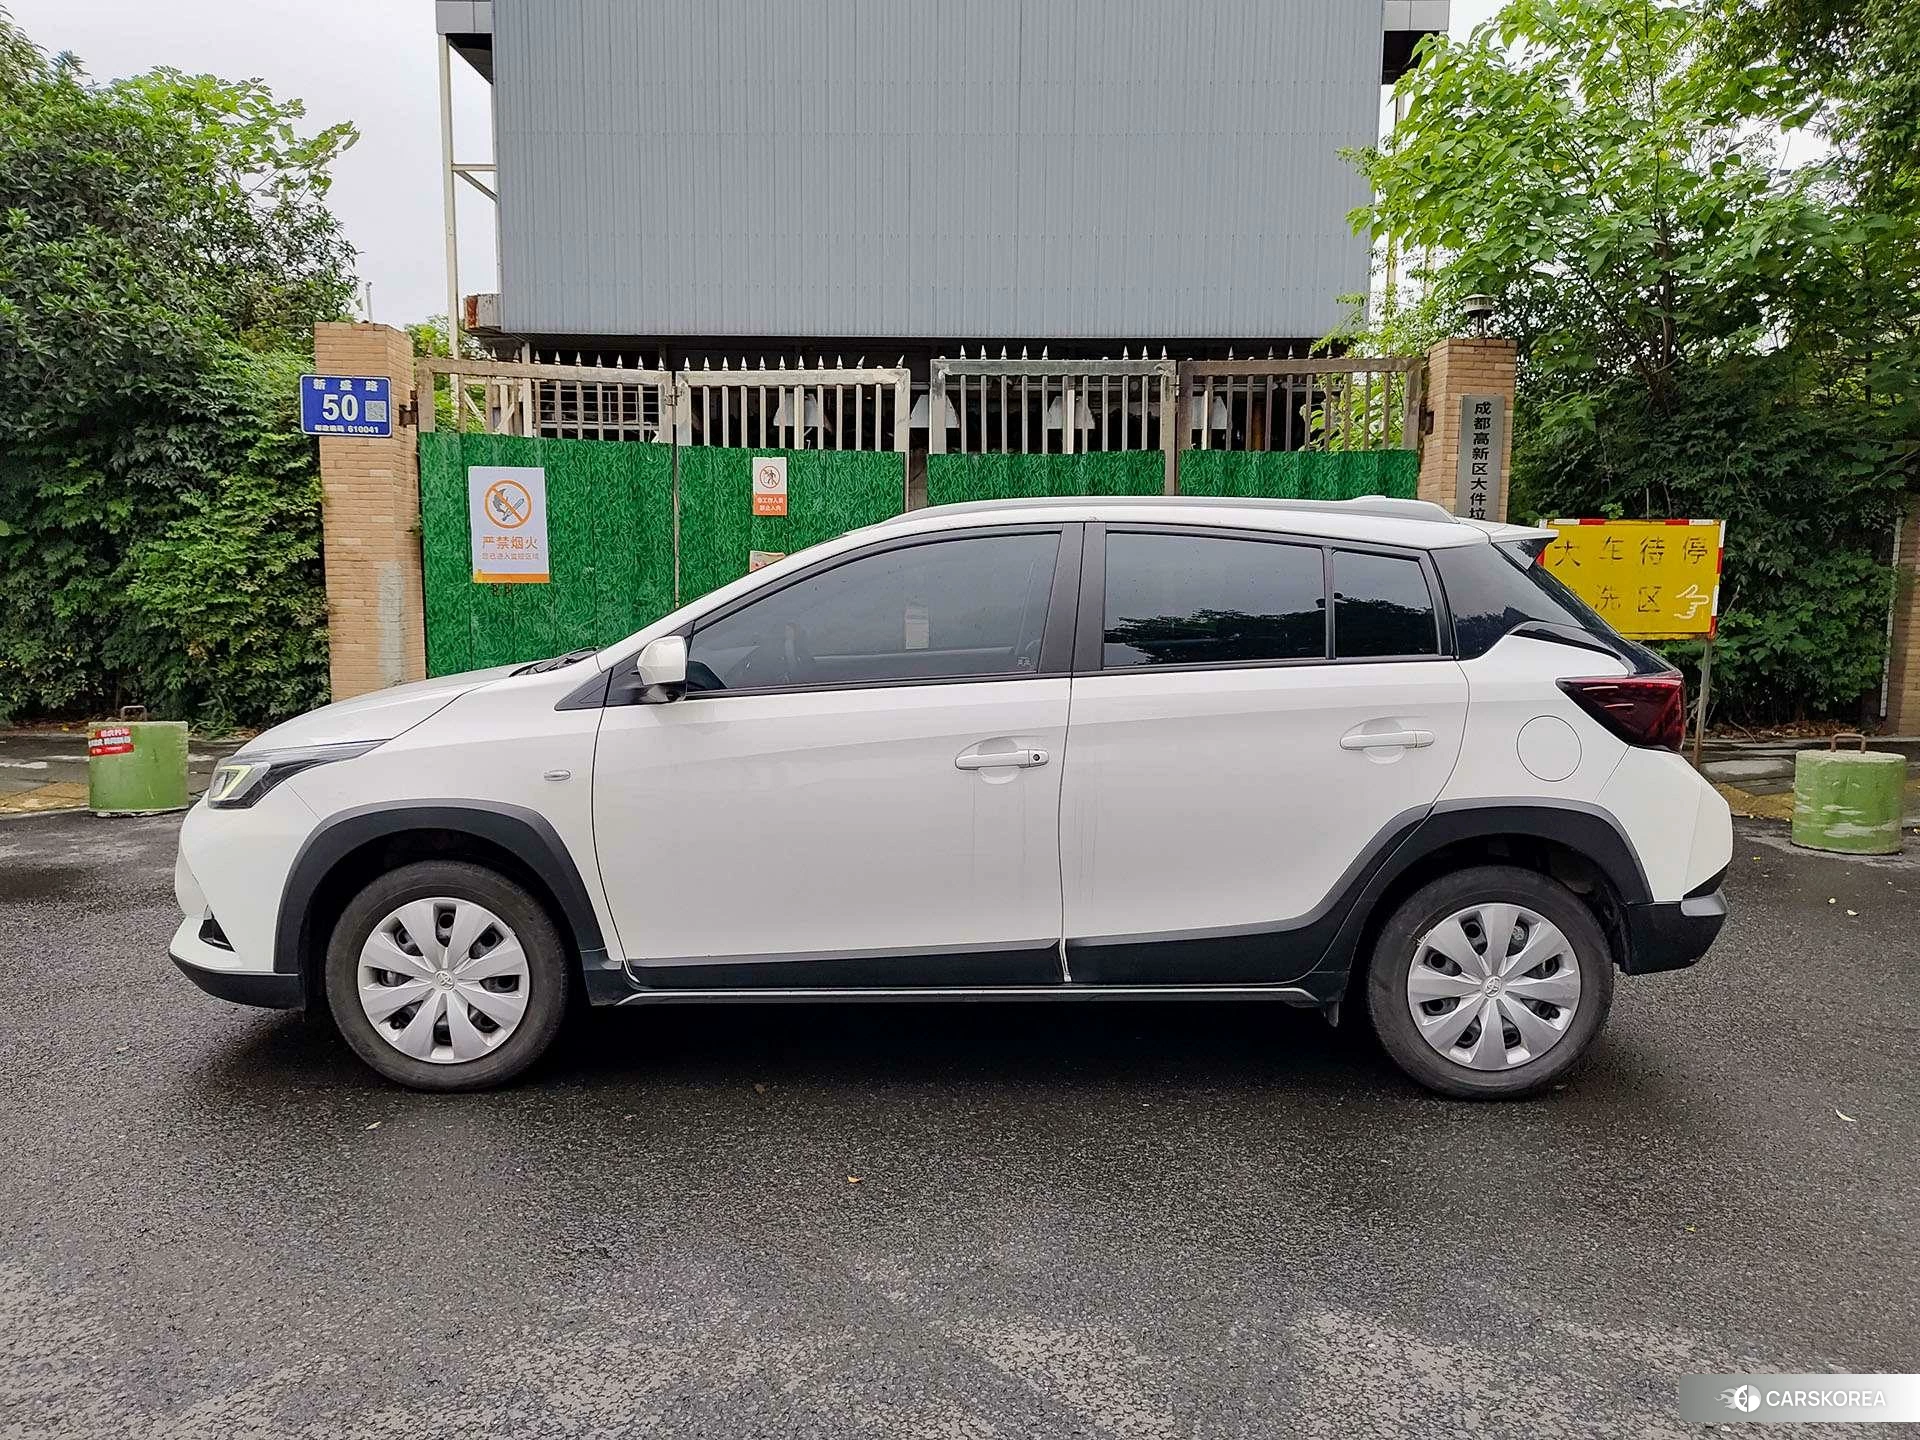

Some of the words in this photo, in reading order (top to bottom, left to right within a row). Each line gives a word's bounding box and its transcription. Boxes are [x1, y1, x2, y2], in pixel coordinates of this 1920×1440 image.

[322, 394, 359, 421] 50
[347, 425, 379, 434] 610041
[1469, 401, 1492, 520] 成都高新区大件垃
[481, 535, 538, 549] 严禁烟火
[1568, 584, 1662, 613] 洗区
